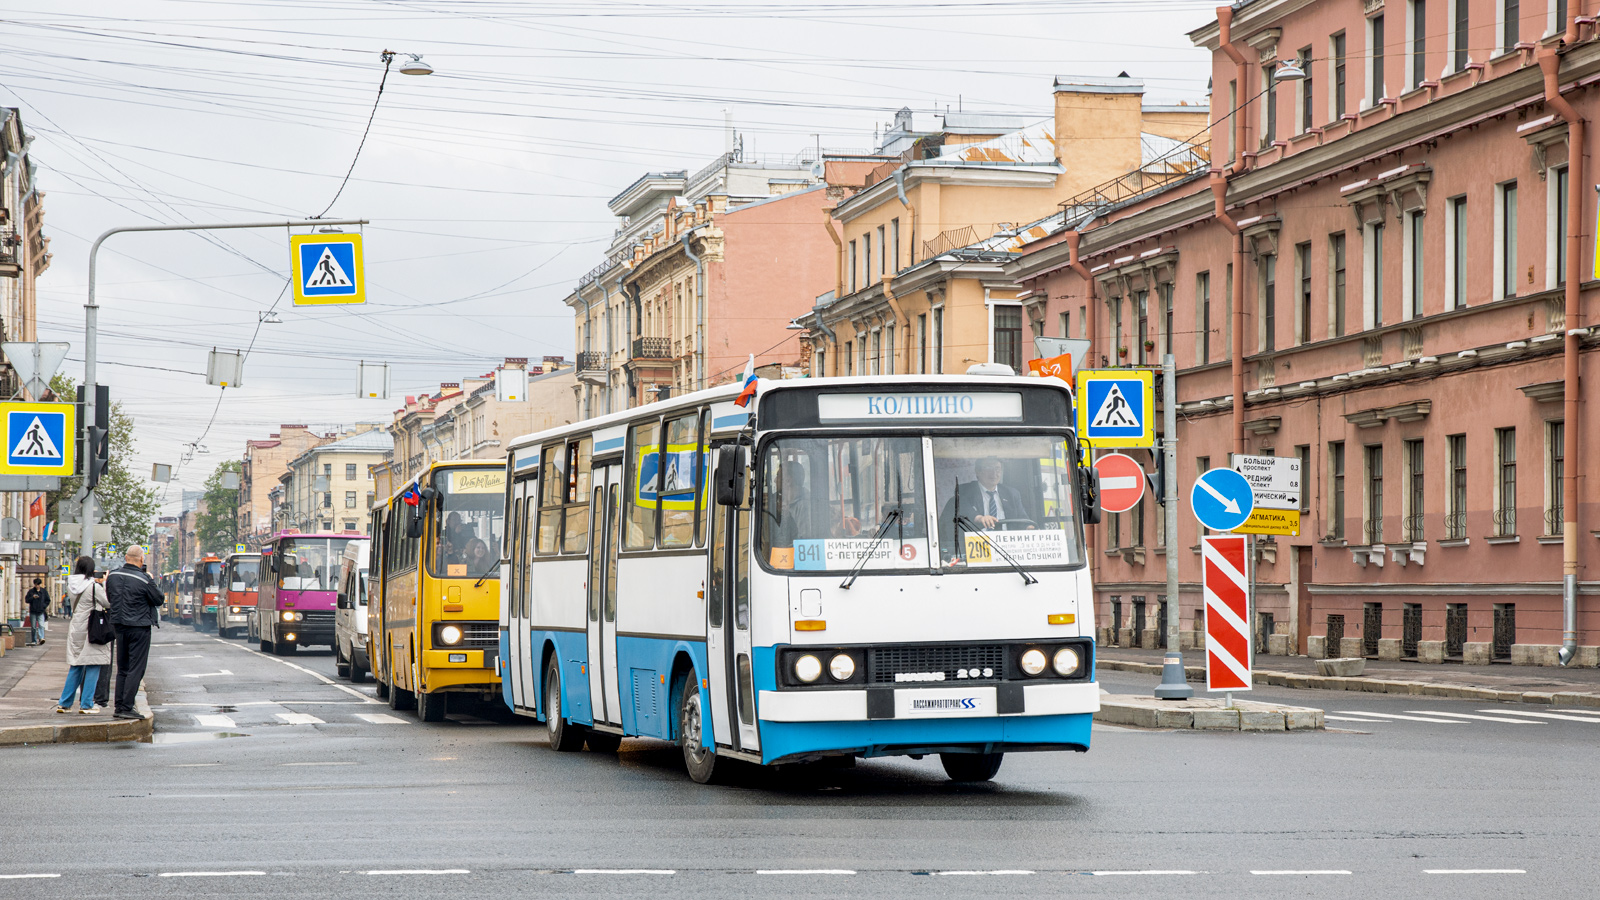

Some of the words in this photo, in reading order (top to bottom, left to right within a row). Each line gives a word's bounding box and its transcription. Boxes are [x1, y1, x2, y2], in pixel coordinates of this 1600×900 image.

[867, 395, 973, 415] КОЛПИНО
[1243, 457, 1275, 465] БОЛЬШОЙ
[798, 544, 820, 562] 841
[827, 541, 890, 550] КИНГИСЕПП
[904, 547, 912, 559] 5
[968, 541, 990, 559] 296
